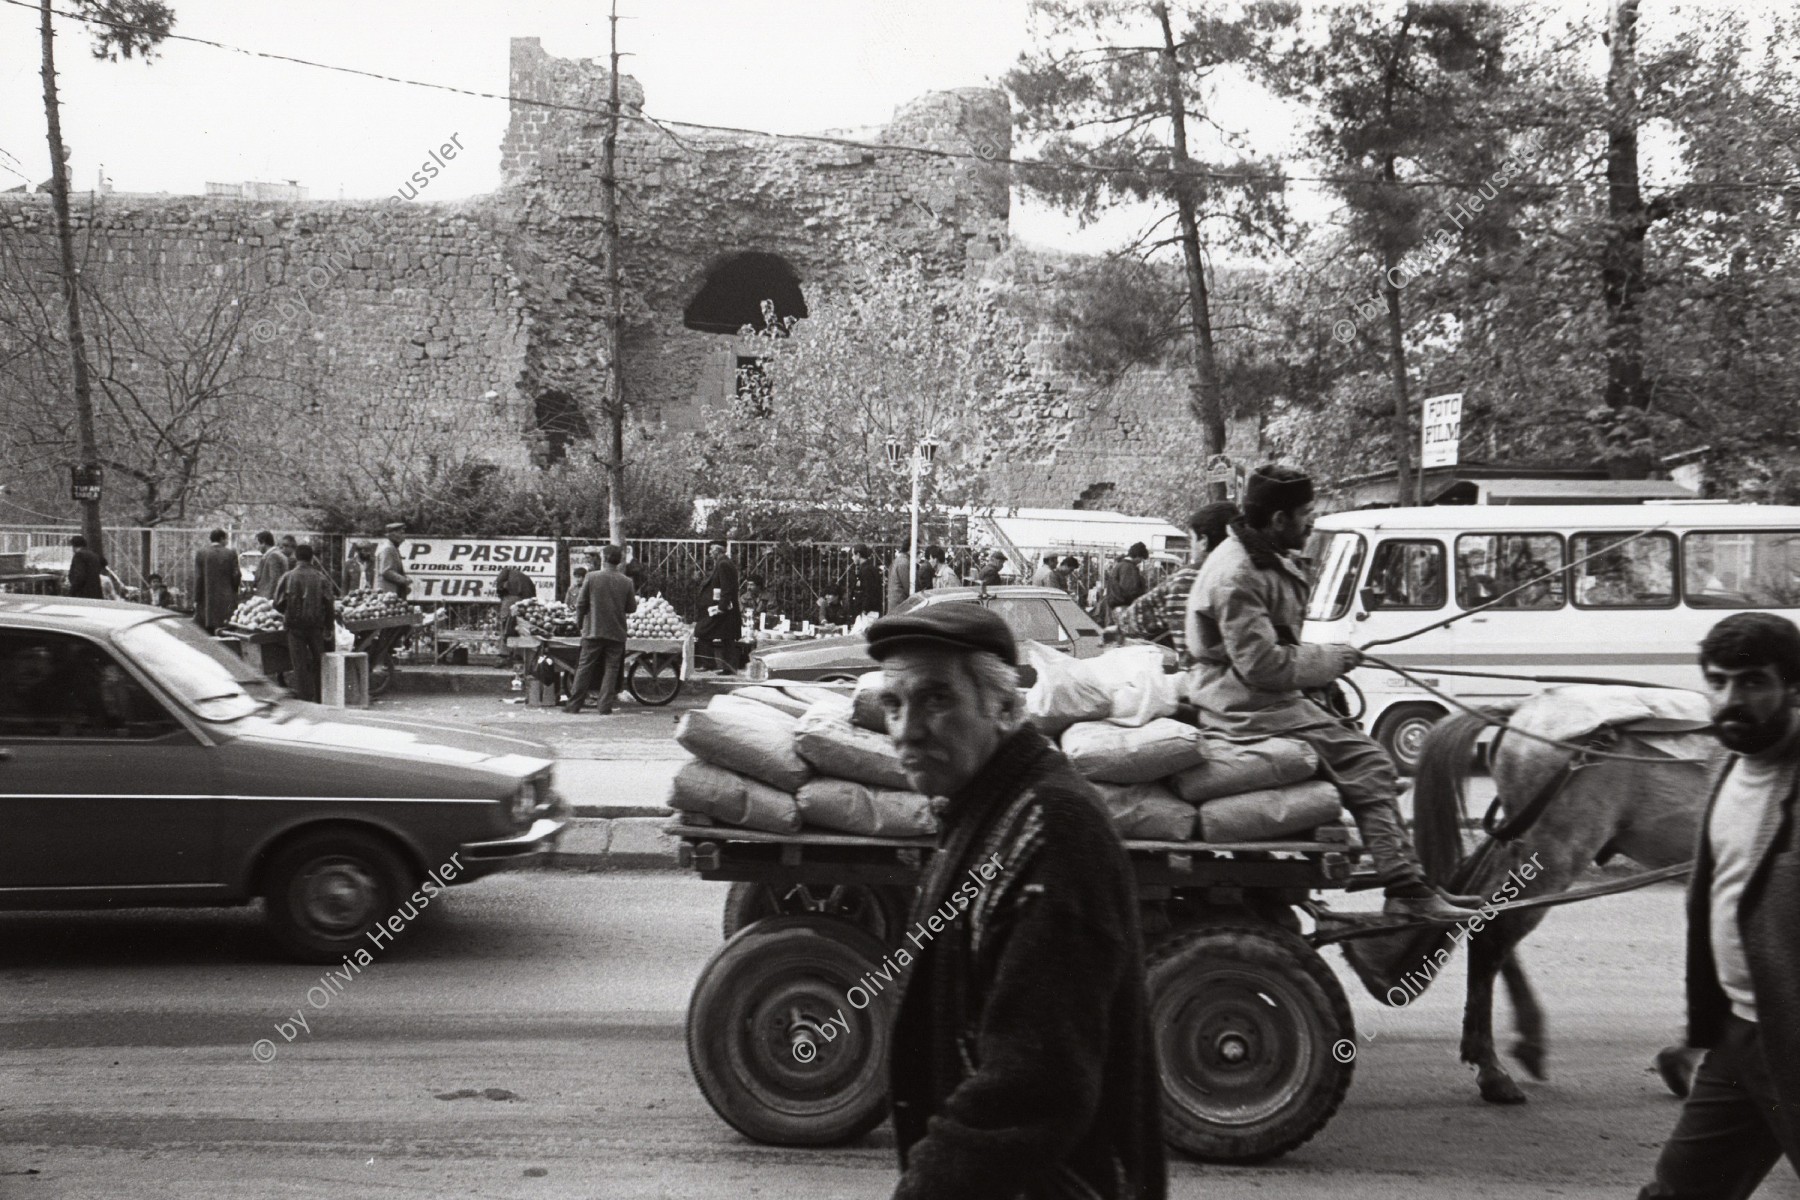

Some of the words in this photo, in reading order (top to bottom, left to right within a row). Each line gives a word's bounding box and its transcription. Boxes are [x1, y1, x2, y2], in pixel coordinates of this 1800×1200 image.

[1428, 398, 1459, 419] FOTO
[1425, 422, 1461, 444] FILM
[449, 544, 555, 563] PASUR
[421, 579, 484, 597] TUR
